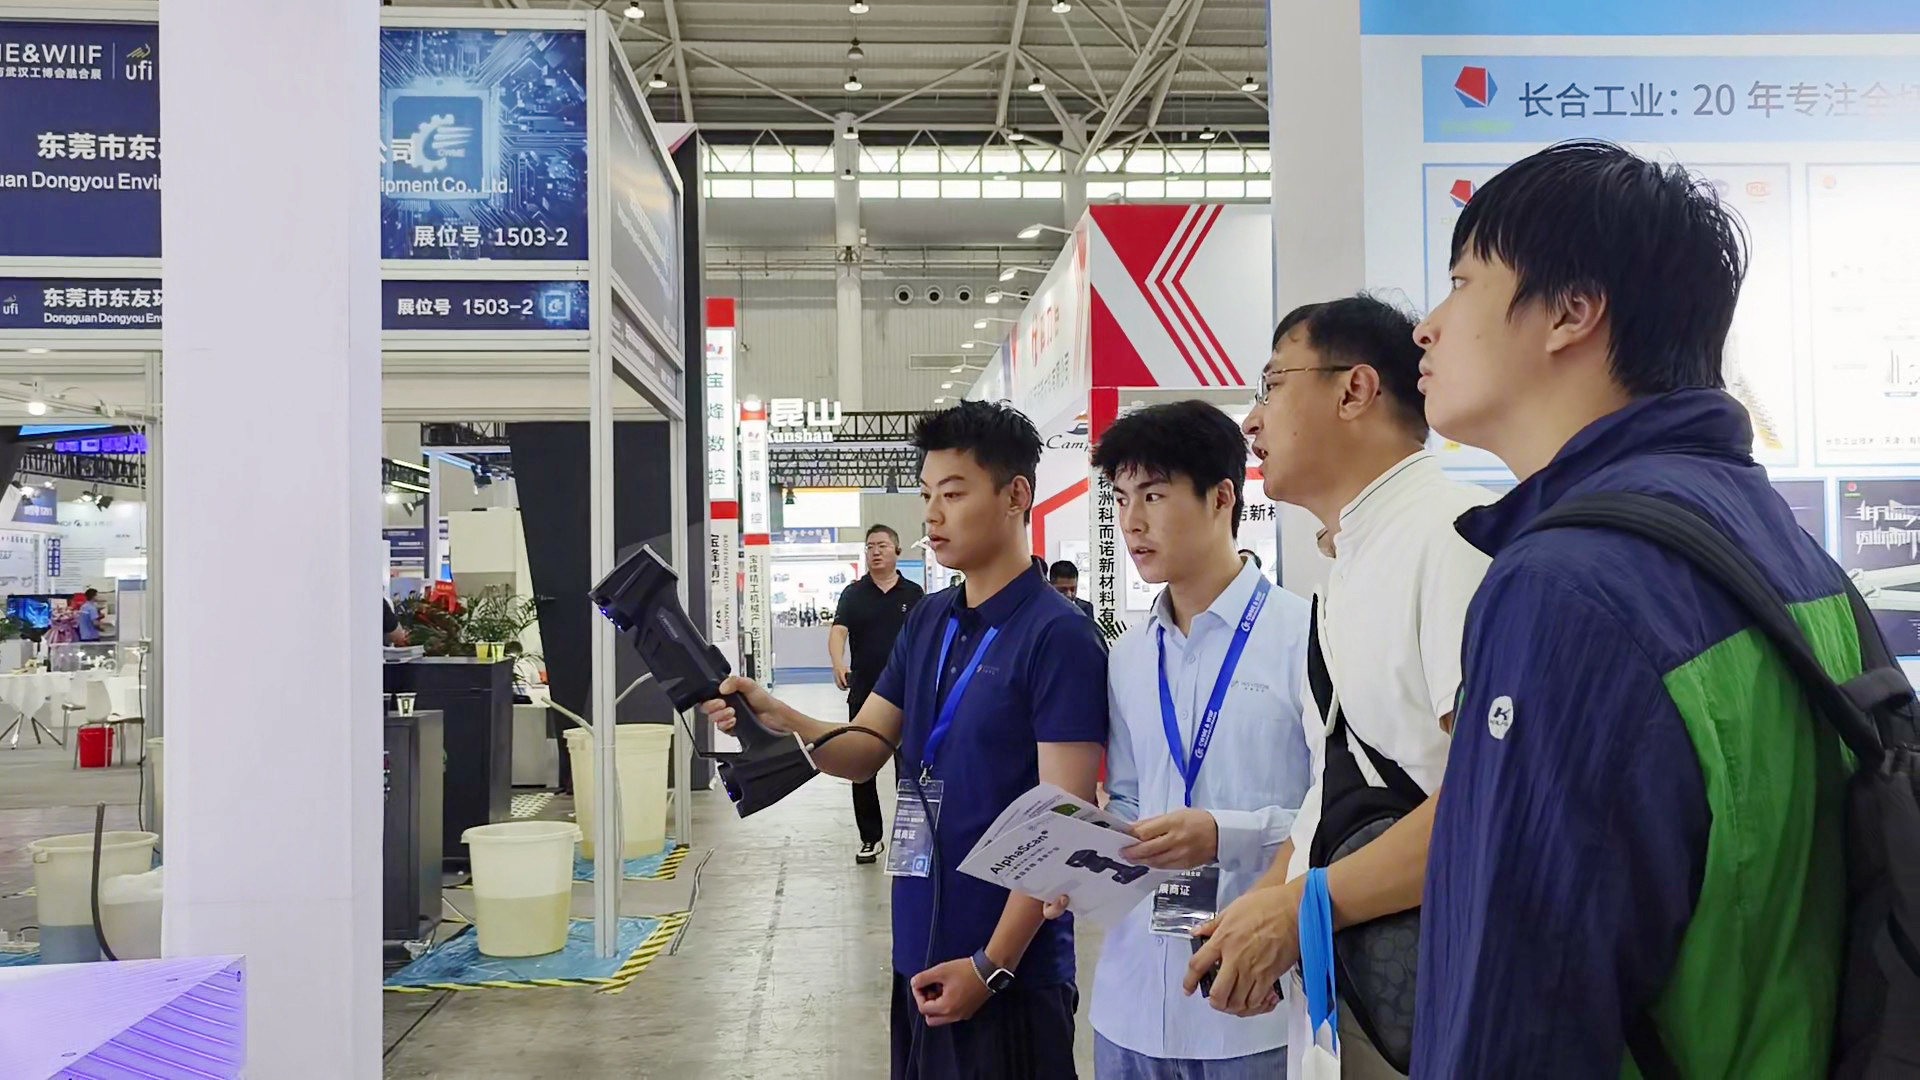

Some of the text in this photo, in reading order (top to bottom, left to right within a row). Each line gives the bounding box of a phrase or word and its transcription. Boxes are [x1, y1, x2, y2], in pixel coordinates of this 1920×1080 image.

[0, 44, 102, 64] E&WIIF
[126, 61, 152, 80] ufi
[37, 132, 161, 161] 东莞市东
[32, 171, 114, 192] Dongyou
[442, 177, 478, 194] Co.,
[482, 178, 513, 194] Ltd.
[413, 225, 569, 248] 展位号 1503-2
[2, 303, 19, 315] ufi
[397, 298, 534, 316] 展位号 1503-2
[44, 313, 97, 325] Dongguan
[99, 313, 145, 325] Dongyou
[771, 398, 842, 427] 昆山
[1159, 884, 1191, 896] 展商证
